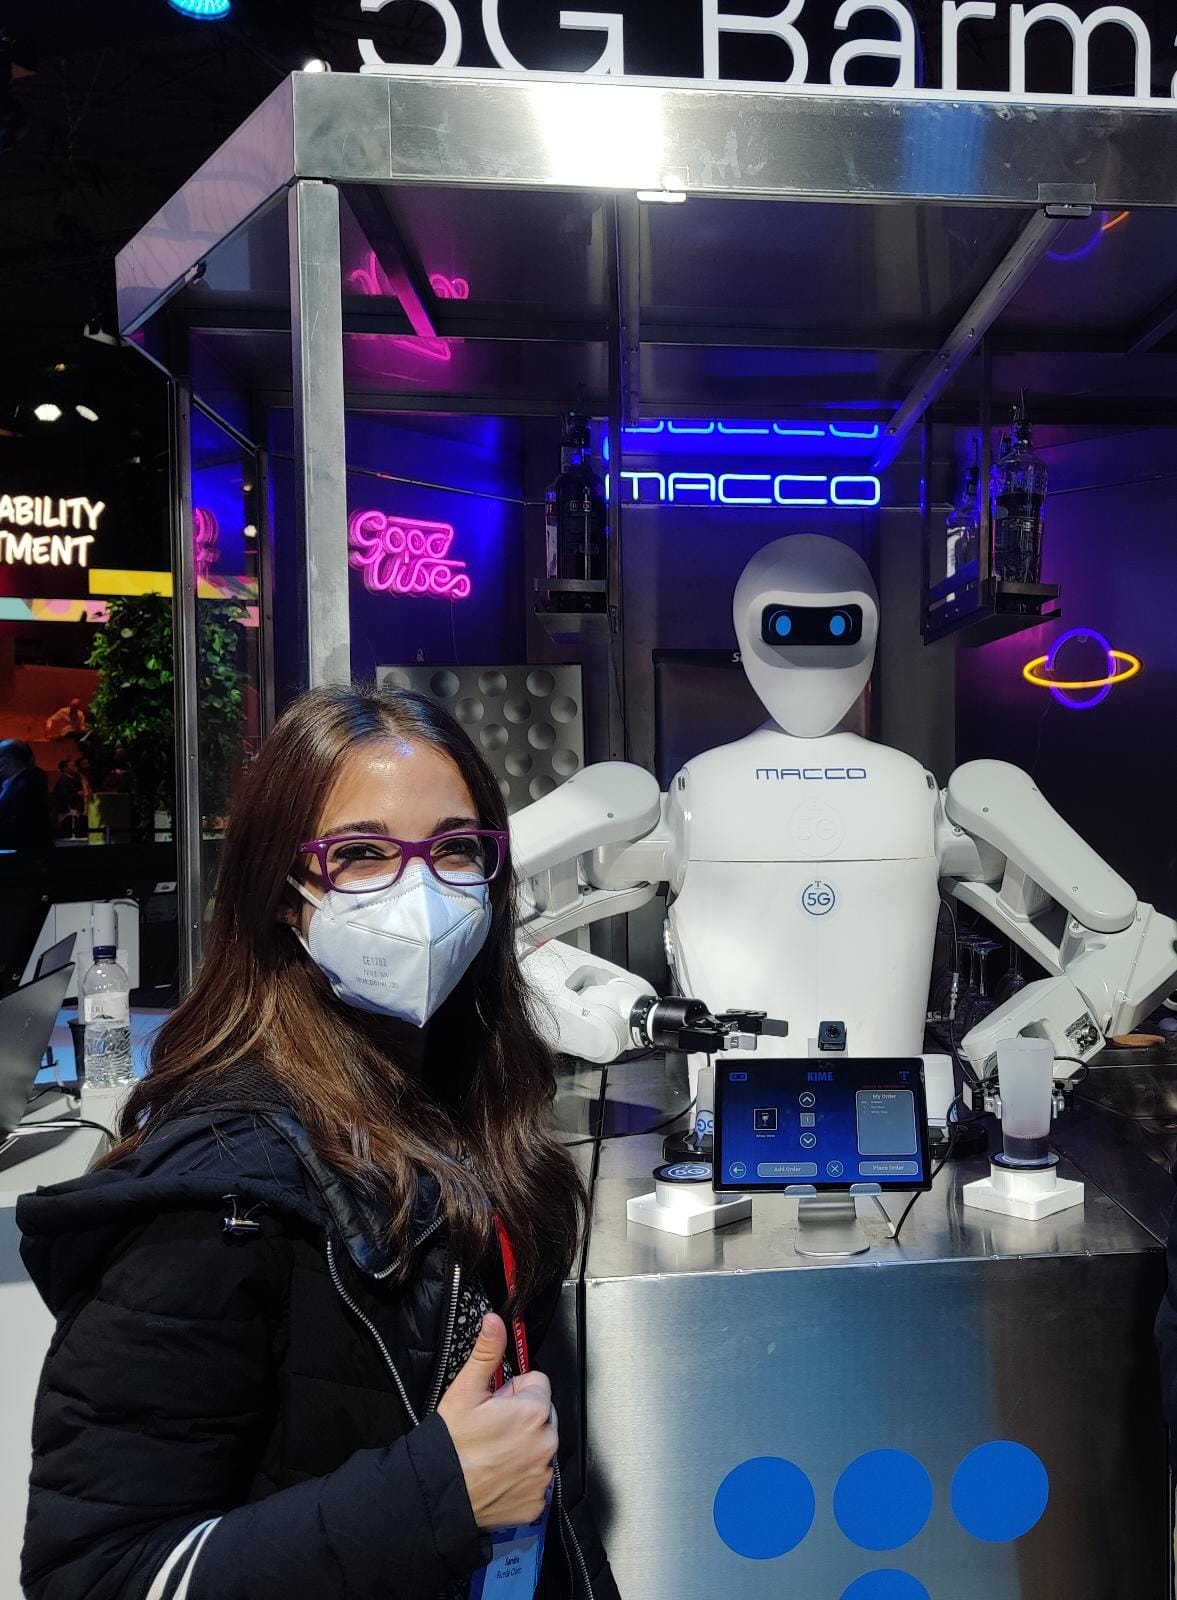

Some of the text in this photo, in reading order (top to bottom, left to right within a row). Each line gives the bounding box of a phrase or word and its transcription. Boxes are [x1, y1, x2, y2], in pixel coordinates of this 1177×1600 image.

[702, 0, 1177, 101] Barm
[605, 471, 880, 506] MACCO
[0, 494, 105, 531] ABILITY
[350, 509, 454, 564] Good
[756, 768, 867, 780] MACCO
[807, 892, 831, 906] 5G
[807, 1071, 833, 1082] KIME
